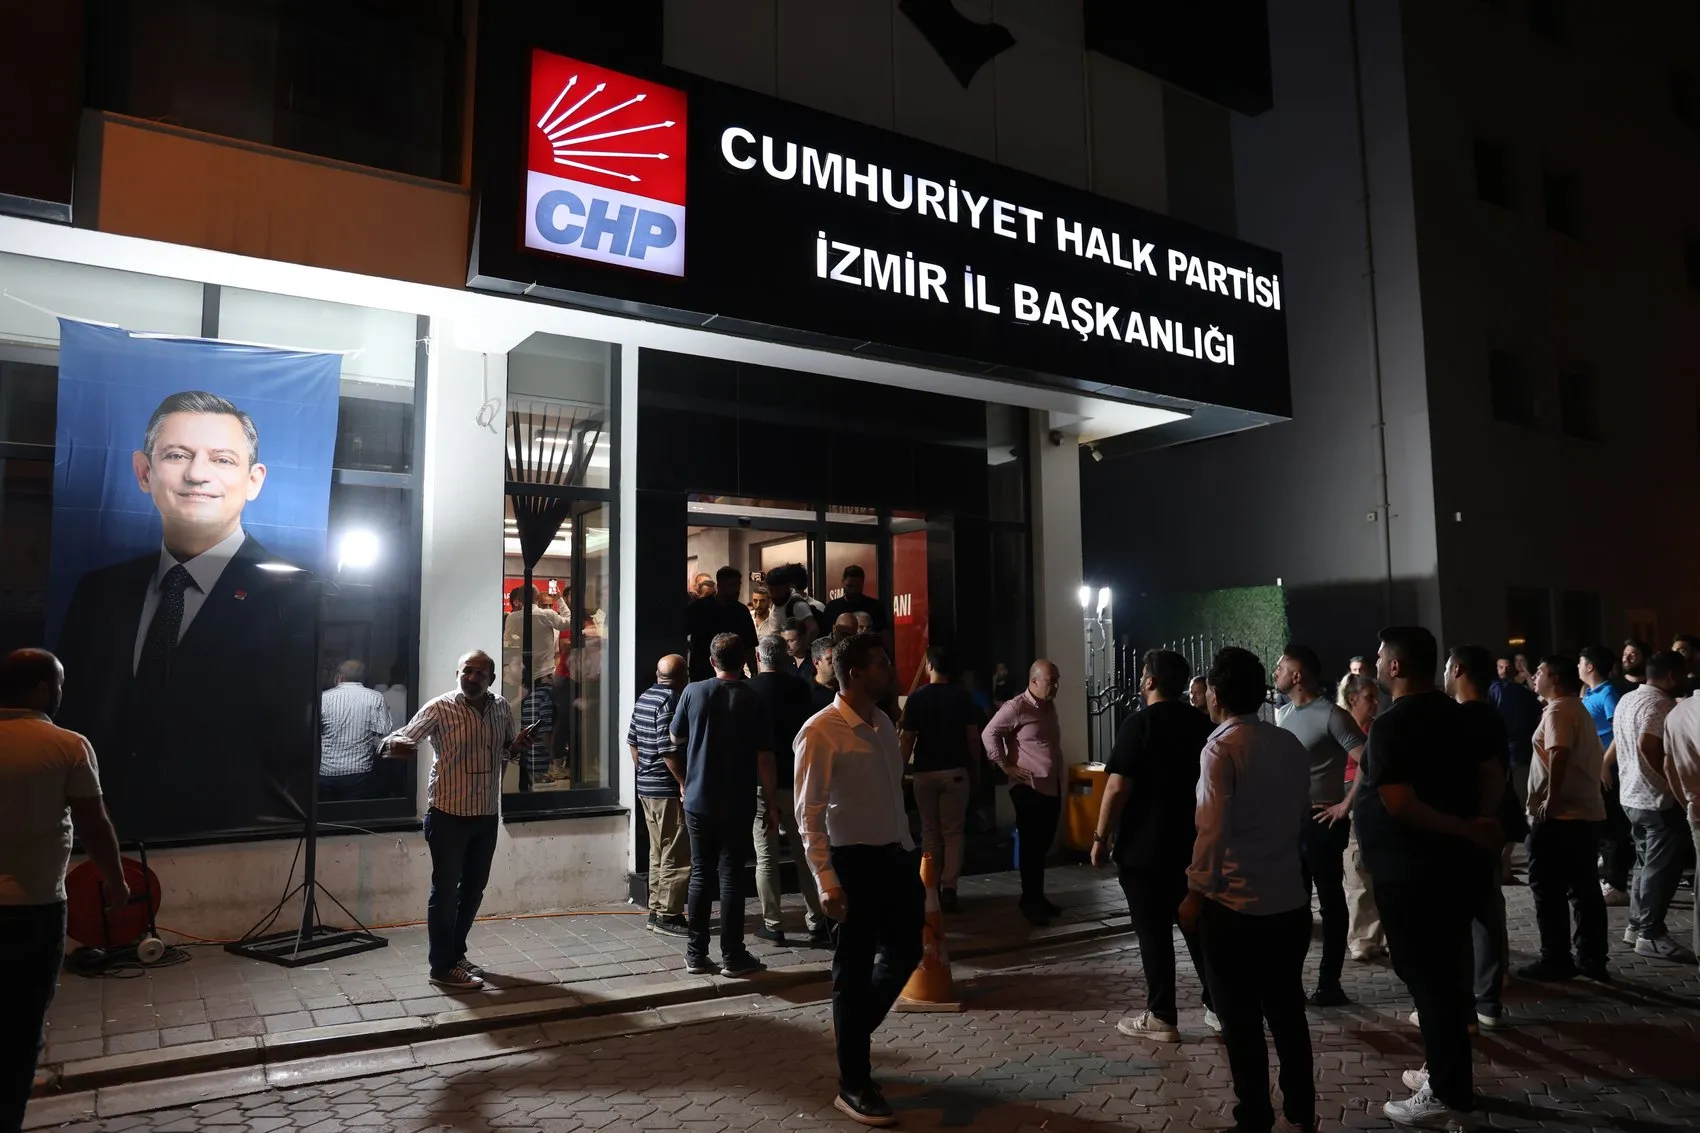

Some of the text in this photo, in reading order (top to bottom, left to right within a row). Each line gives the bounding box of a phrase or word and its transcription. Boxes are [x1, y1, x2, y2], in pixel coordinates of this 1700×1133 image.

[535, 190, 677, 260] CHP
[721, 127, 1281, 311] CUMHURİYET HALK PARTİSİ
[817, 230, 1235, 366] İZMİR İL BAŞKANLIĞI
[894, 594, 911, 617] ANI
